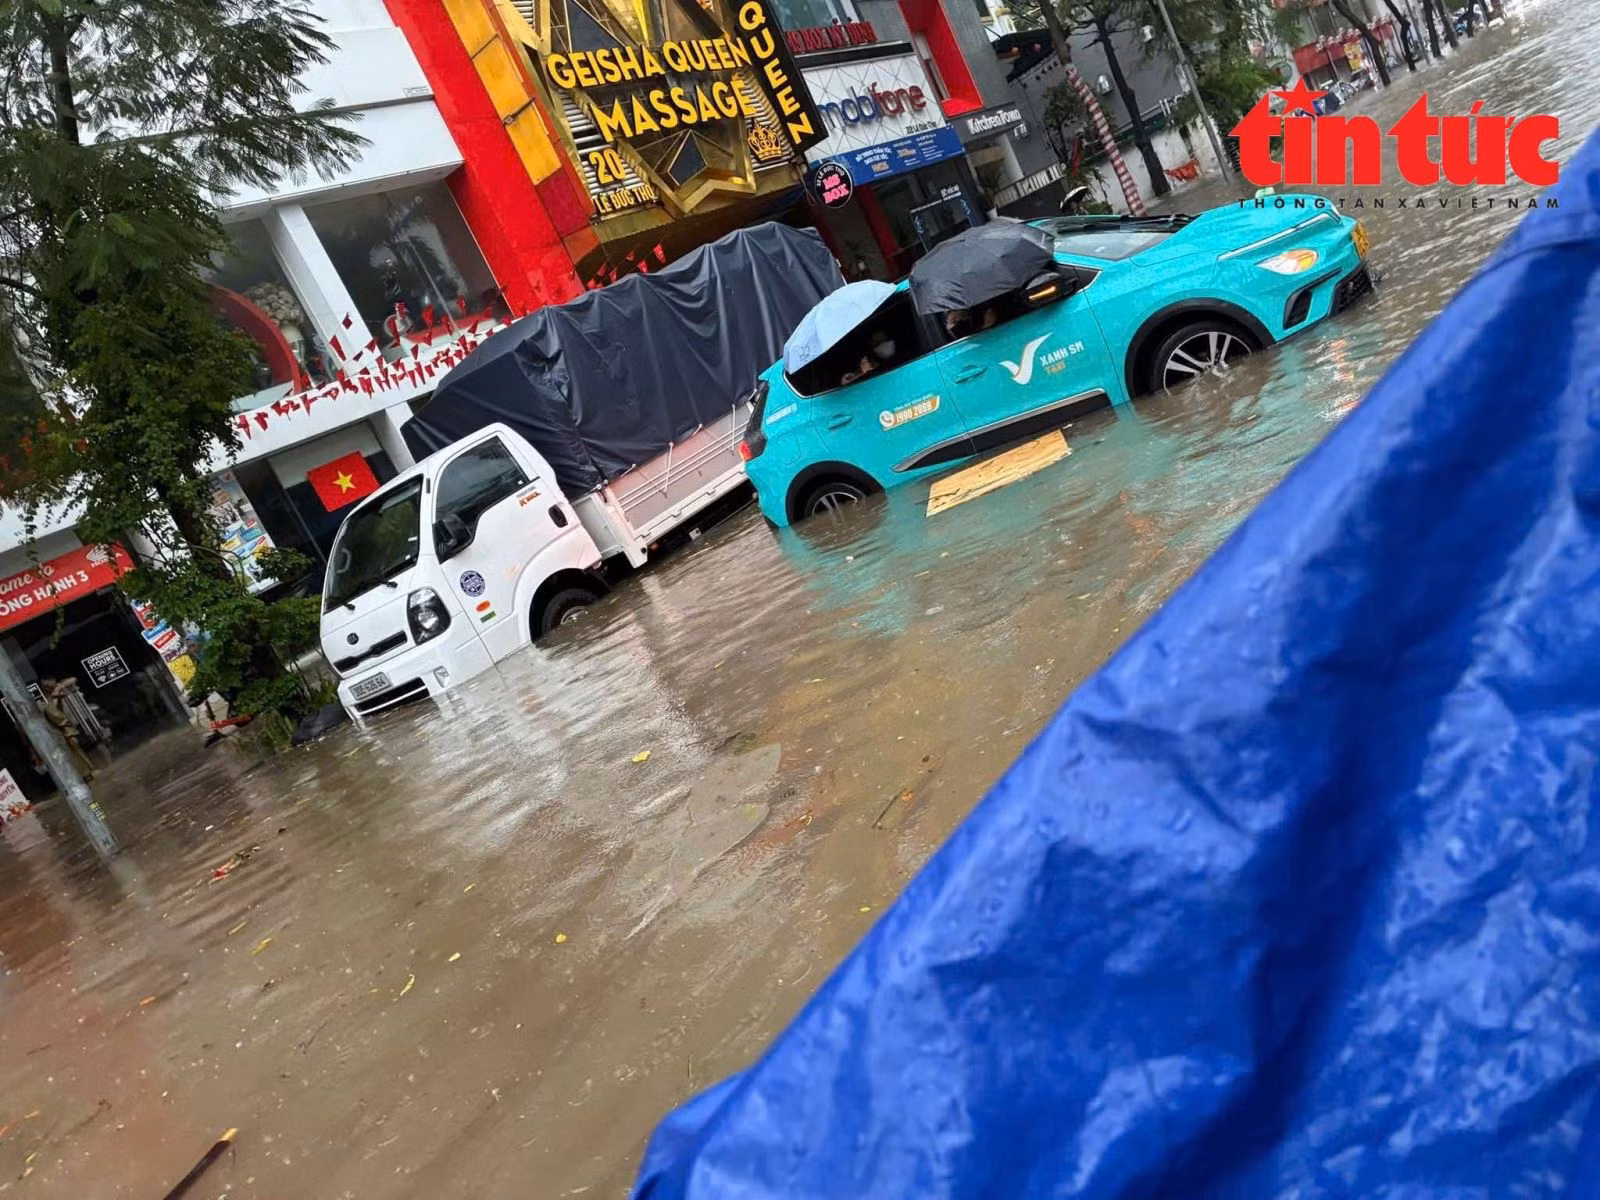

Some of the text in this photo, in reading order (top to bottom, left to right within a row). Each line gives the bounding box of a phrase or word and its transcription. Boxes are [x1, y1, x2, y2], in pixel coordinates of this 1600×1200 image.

[547, 37, 752, 89] GEISHA QUEEN
[739, 1, 814, 145] QUEEN
[590, 79, 757, 142] MASSAGE
[589, 147, 625, 184] 20
[823, 183, 849, 204] BOX
[1040, 340, 1085, 367] XANH SM
[76, 570, 89, 583] 3
[87, 650, 112, 665] OPENING
[90, 655, 116, 670] HOURS
